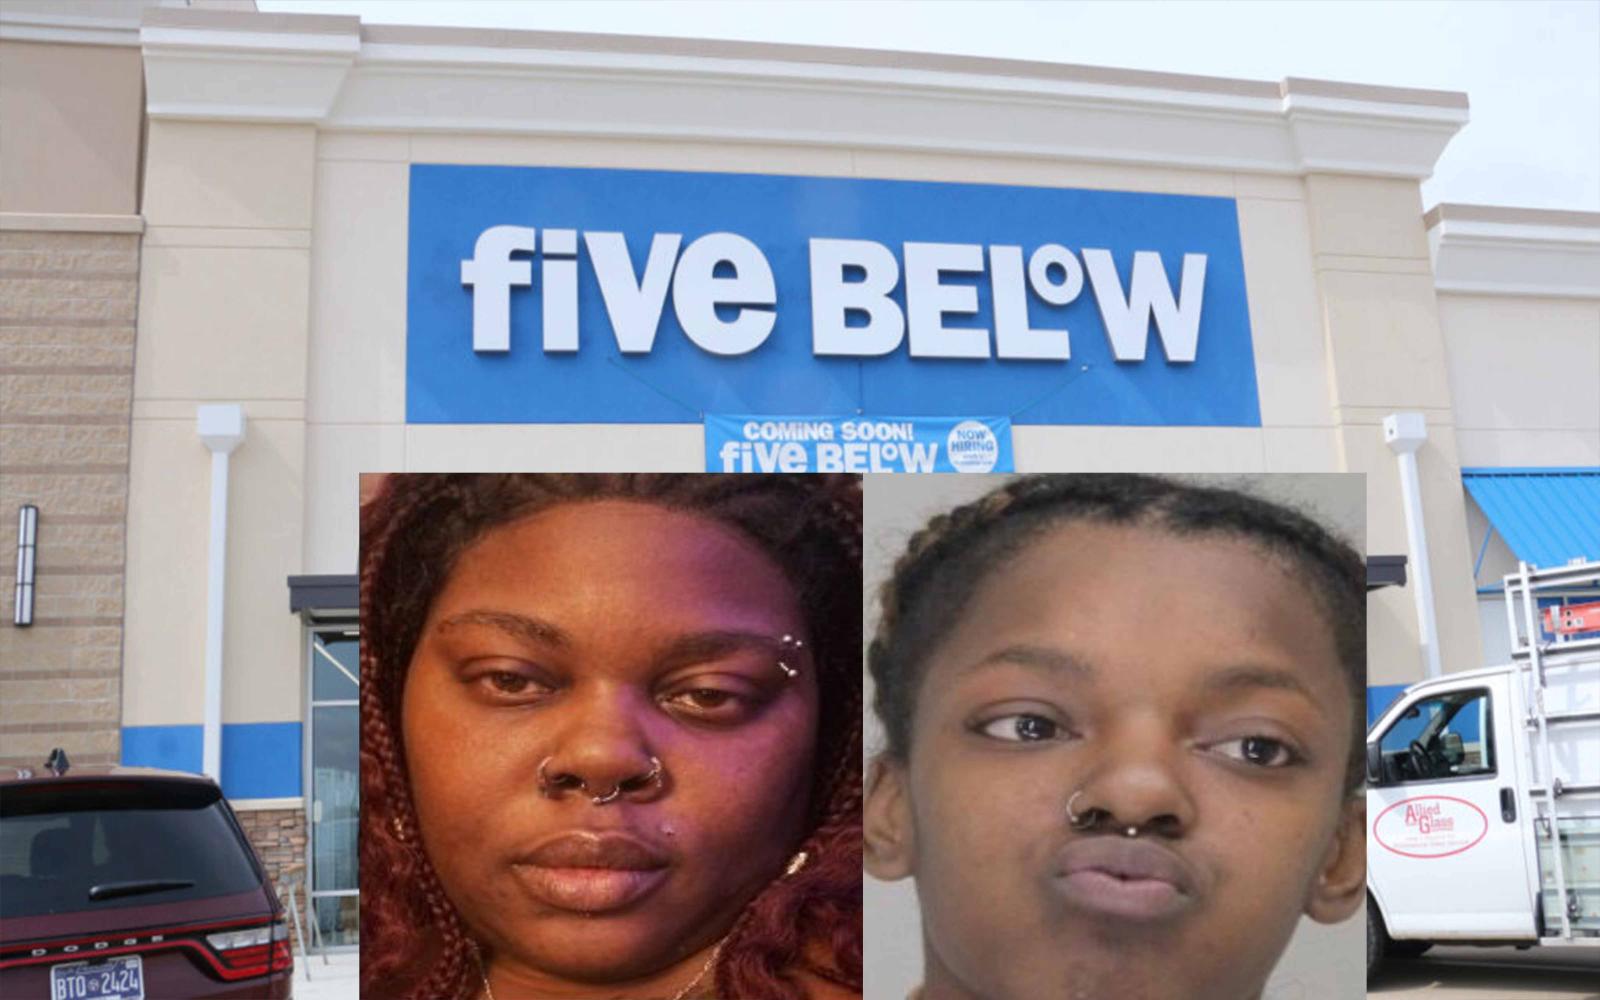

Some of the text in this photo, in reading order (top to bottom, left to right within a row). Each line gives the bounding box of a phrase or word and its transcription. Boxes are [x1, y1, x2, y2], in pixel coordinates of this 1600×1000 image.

[841, 422, 913, 441] SOON!
[956, 429, 986, 440] NOW
[951, 440, 994, 452] HIRING
[1405, 803, 1440, 826] Allied
[1418, 815, 1454, 834] Glass
[101, 969, 139, 995] 2424
